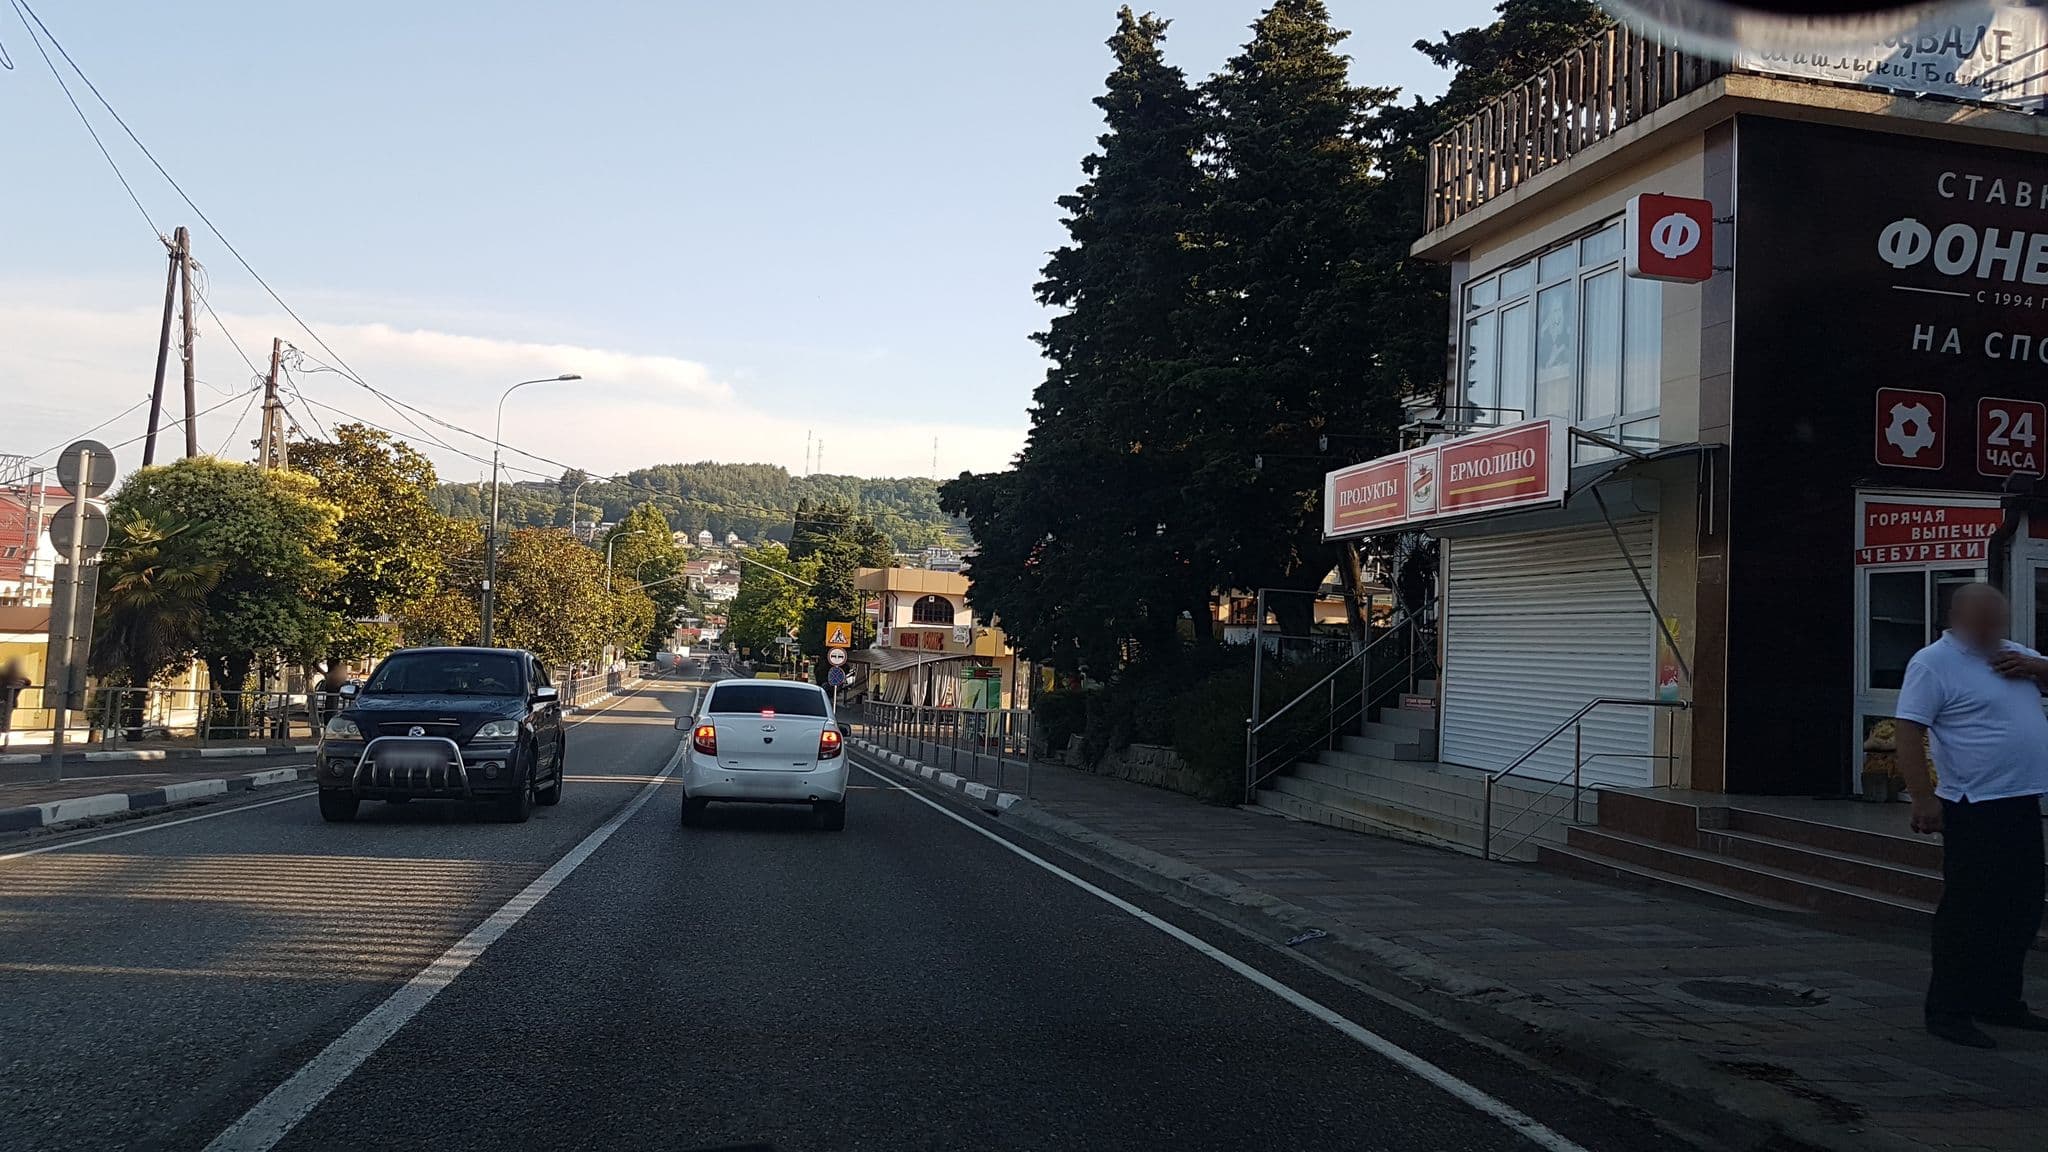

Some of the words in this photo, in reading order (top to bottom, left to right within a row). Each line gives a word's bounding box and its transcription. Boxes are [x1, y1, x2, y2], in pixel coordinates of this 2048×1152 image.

[1976, 290, 1986, 303] С
[1994, 292, 2033, 309] 1994
[1912, 323, 1962, 354] НА
[1987, 408, 2037, 448] 24
[1449, 447, 1536, 482] ЕРМОЛИНО
[1986, 449, 2037, 469] ЧАСА
[1339, 478, 1398, 507] ПРОДУКТЫ
[1869, 509, 1946, 527] ГОРЯЧАЯ
[1911, 523, 1997, 541] ВЫПЕЧКА
[1861, 542, 1980, 563] ЧЕБУРЕКИ
